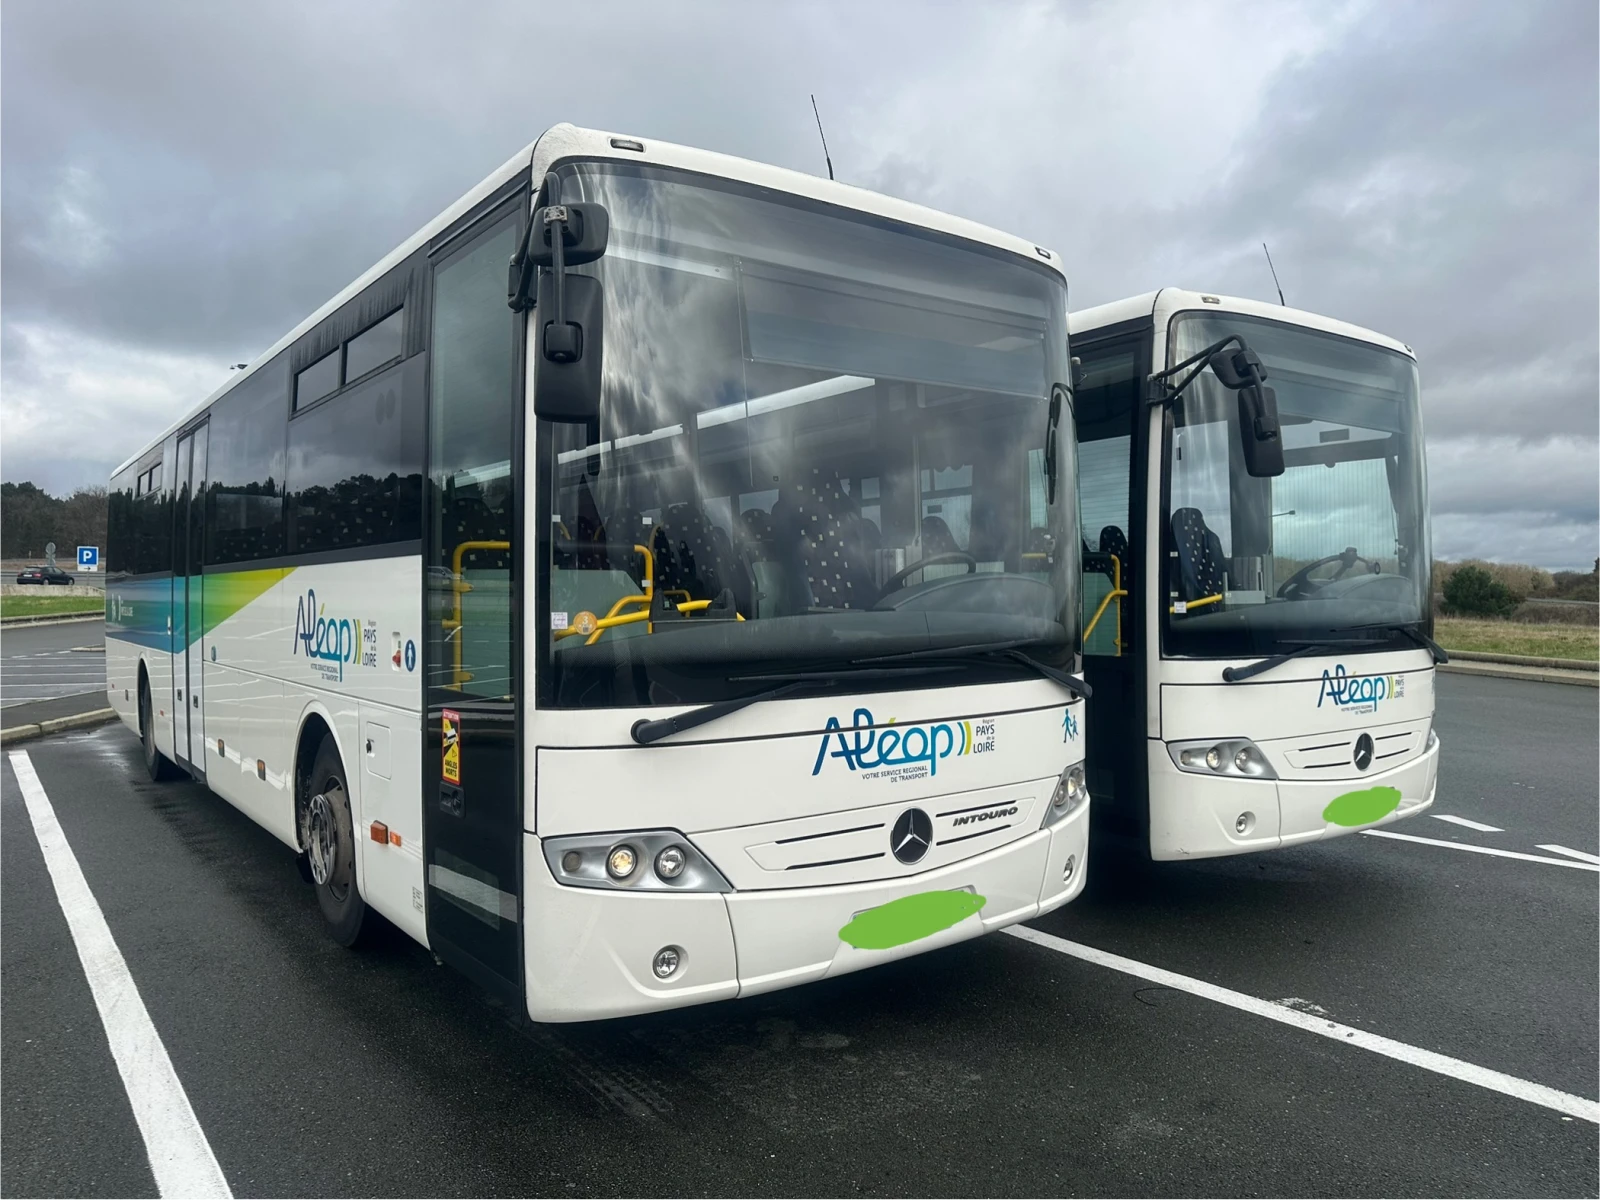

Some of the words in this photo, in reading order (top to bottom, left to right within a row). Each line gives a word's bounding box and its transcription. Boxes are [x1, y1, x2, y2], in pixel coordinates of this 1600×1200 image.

[83, 550, 92, 562] P
[363, 628, 377, 643] PAYS
[361, 652, 377, 668] LOIRE
[976, 724, 995, 736] PAYS
[811, 708, 954, 777] Aléop
[973, 740, 995, 754] LOIRE
[445, 759, 458, 770] ANGLES
[445, 767, 457, 778] MORTS
[862, 771, 880, 780] VOTRE
[880, 769, 902, 778] SERVICE
[898, 772, 928, 782] TRANSPORT
[952, 806, 1019, 827] INTOURO
